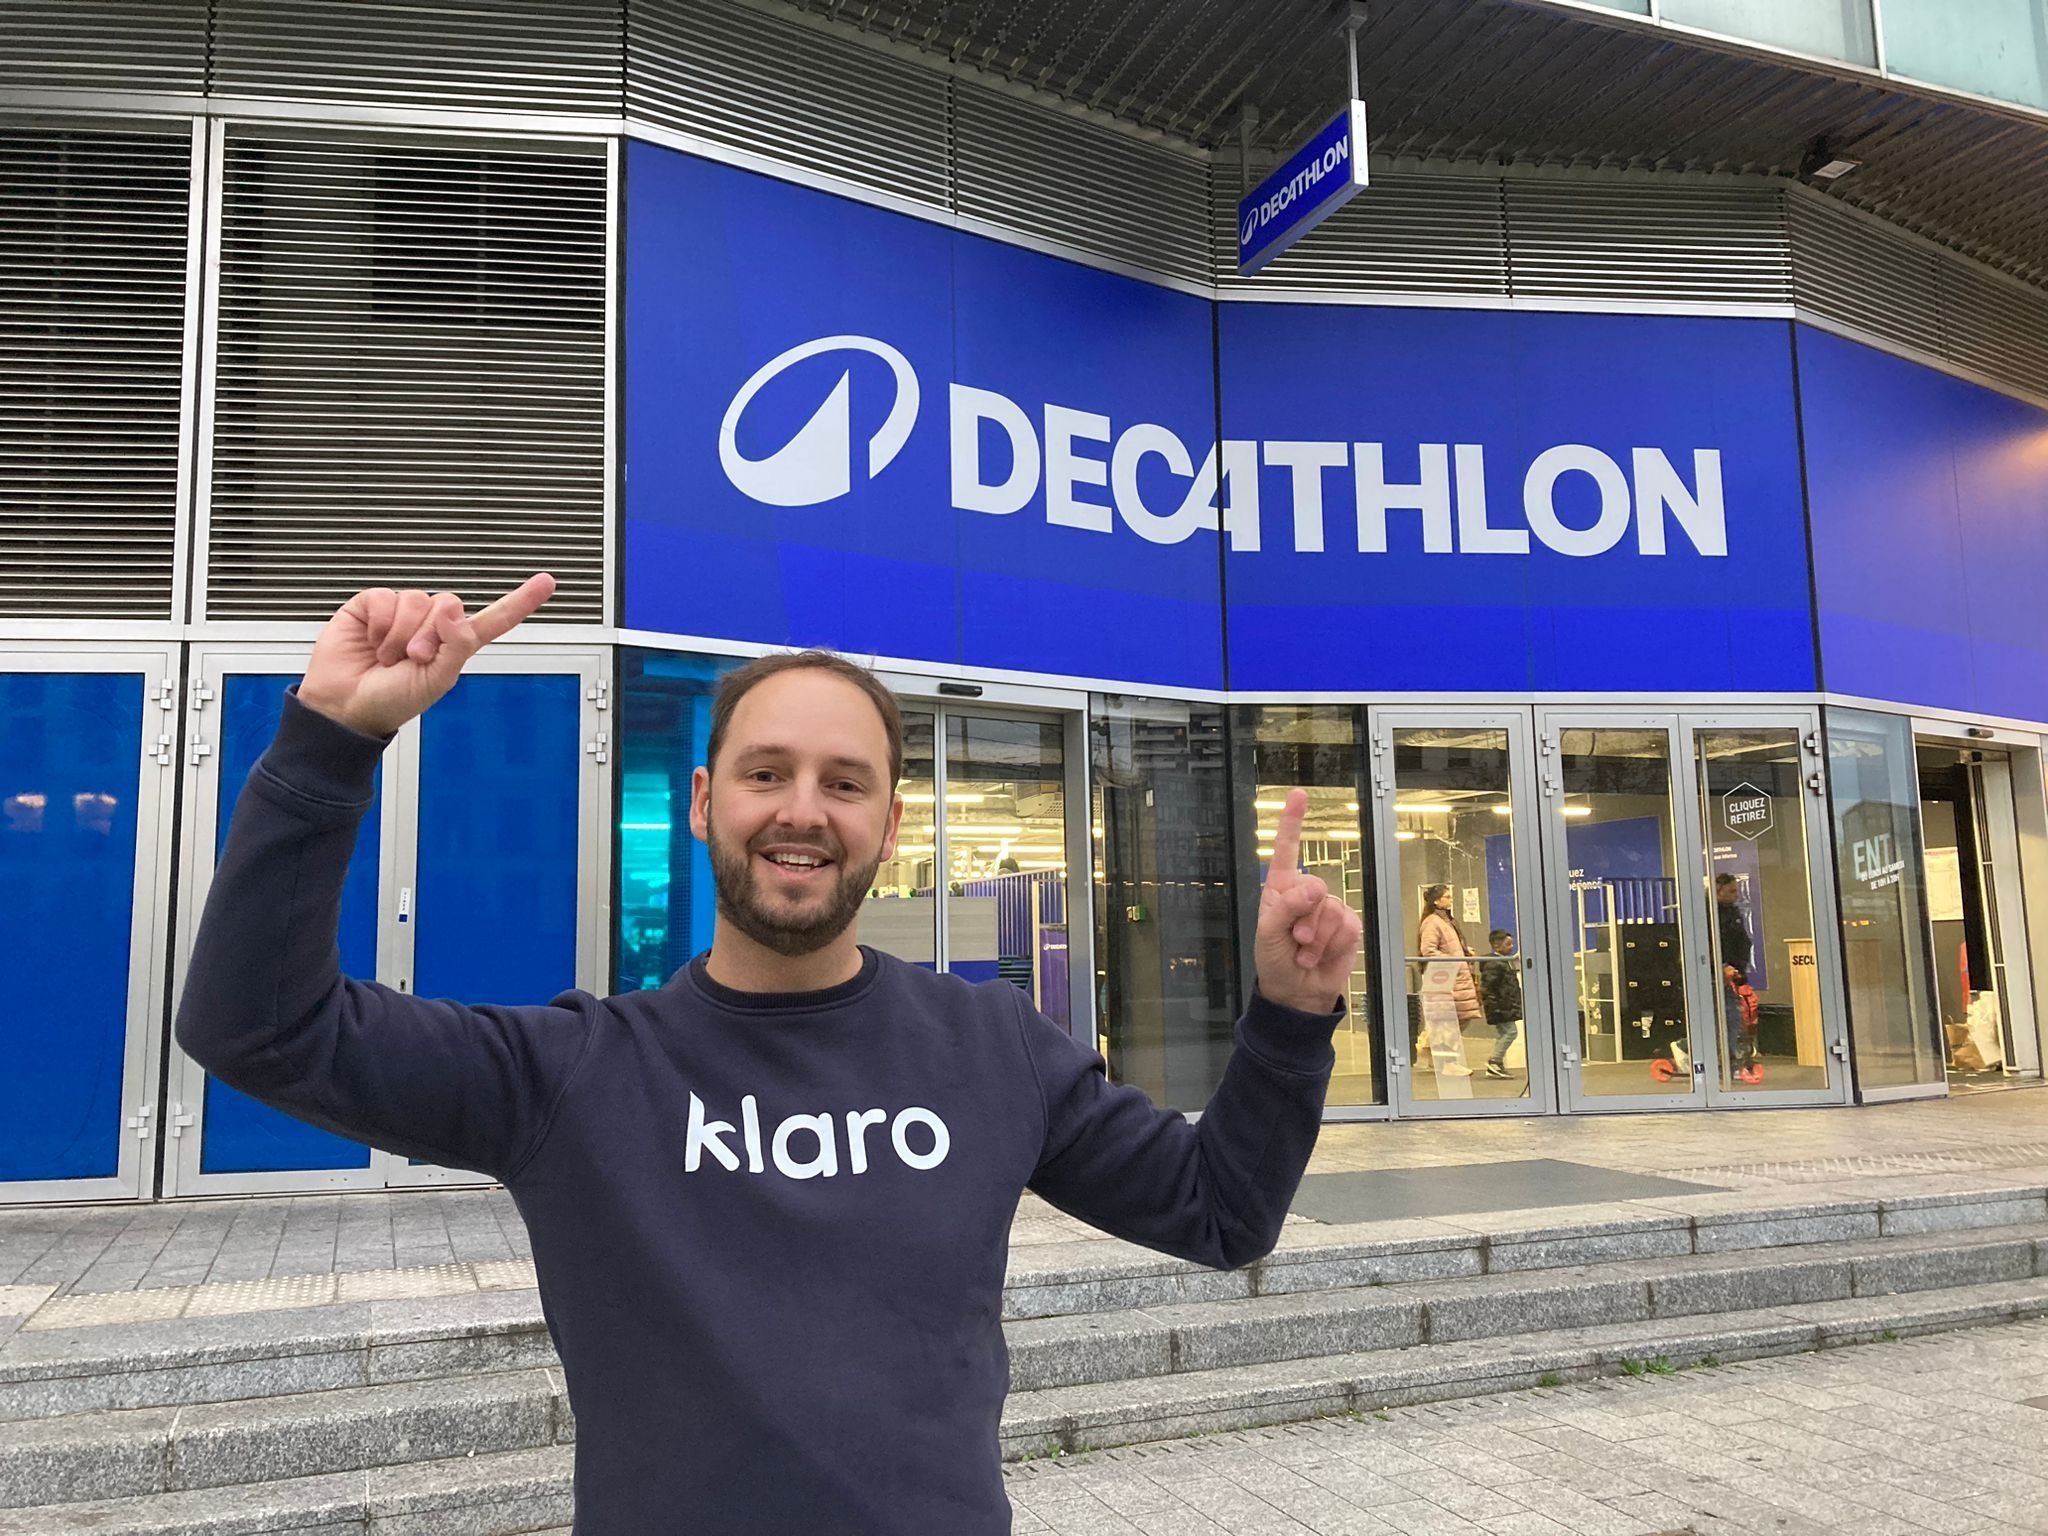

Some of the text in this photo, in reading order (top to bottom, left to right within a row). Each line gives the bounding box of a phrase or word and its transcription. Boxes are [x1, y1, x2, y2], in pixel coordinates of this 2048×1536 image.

[1260, 135, 1348, 227] DECATHLON
[949, 382, 1728, 557] DECATHLON
[1729, 798, 1765, 813] CLIQUEZ
[1730, 809, 1766, 825] RETIREZ
[685, 1090, 951, 1179] klaro
